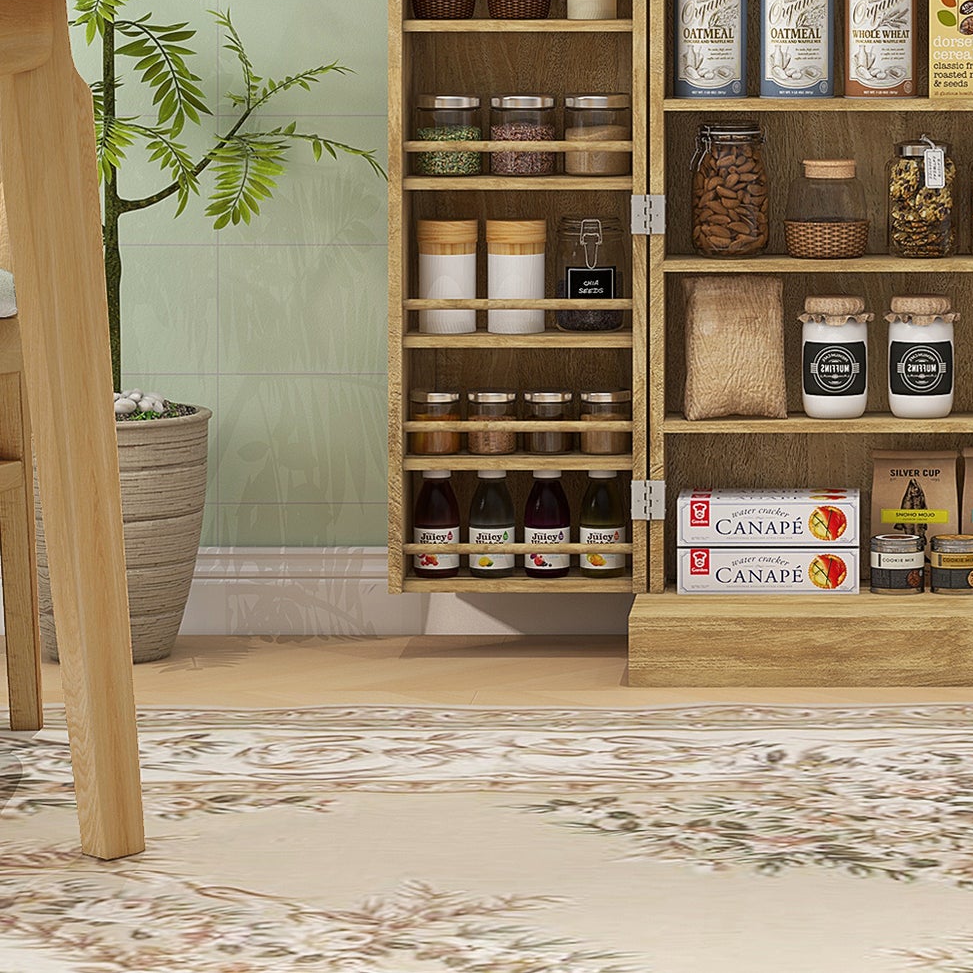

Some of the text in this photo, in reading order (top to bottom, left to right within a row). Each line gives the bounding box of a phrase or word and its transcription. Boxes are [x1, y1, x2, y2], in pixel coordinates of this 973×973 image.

[683, 27, 734, 39] OATMEAL
[770, 27, 822, 39] OATMEAL
[852, 29, 910, 39] WHOLE WHEAT
[890, 469, 940, 477] SILVER CUP
[732, 507, 790, 518] water cracker
[715, 517, 803, 535] CANAPÉ
[421, 533, 447, 541] Juicy
[476, 533, 503, 541] Juicy
[532, 533, 558, 541] Juicy
[587, 533, 614, 541] Juicy
[732, 555, 790, 567] water cracker
[715, 565, 803, 584] CANAPÉ
